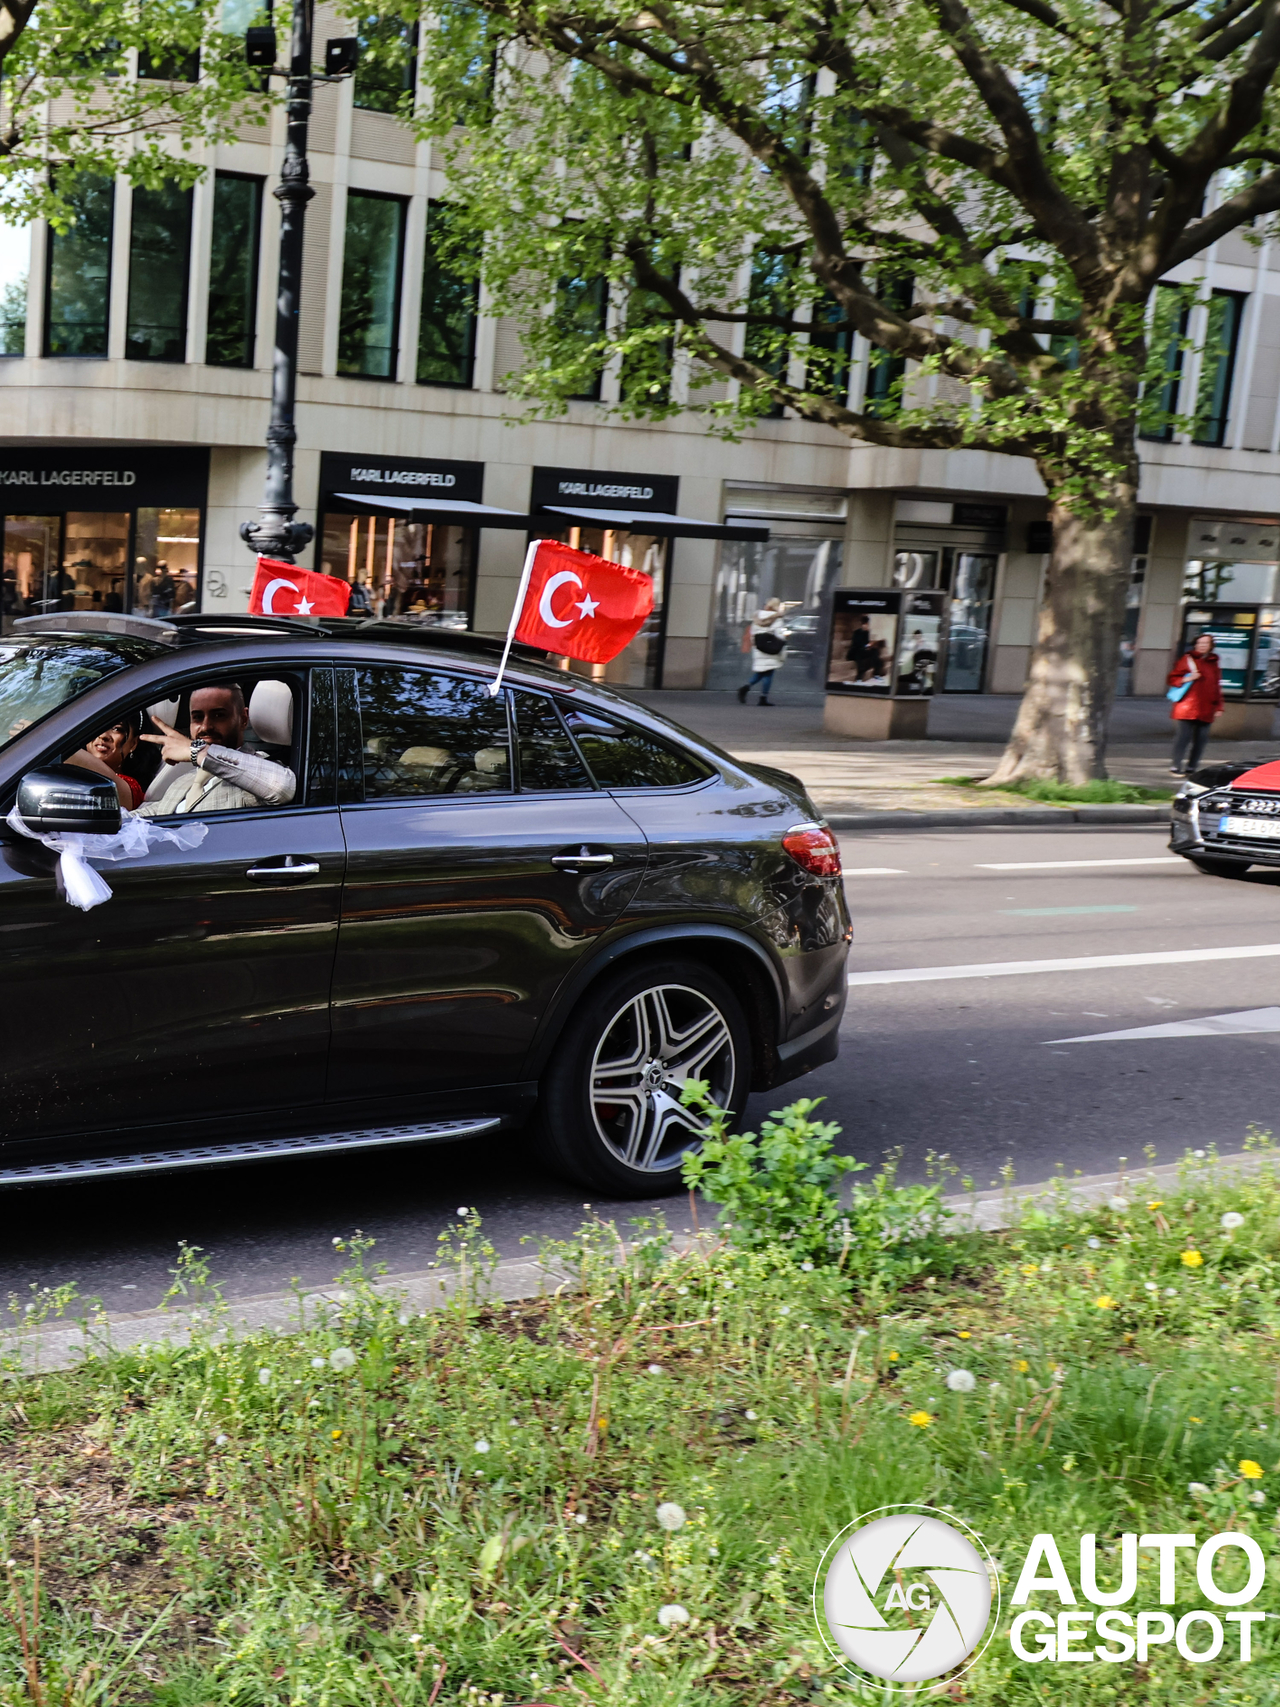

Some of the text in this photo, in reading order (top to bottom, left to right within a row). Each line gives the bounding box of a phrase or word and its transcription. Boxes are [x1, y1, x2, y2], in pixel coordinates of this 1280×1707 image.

[40, 470, 136, 485] LAGERFELD
[350, 467, 456, 487] KARL LAGERFELD
[558, 481, 654, 500] KARL LAGERFELD
